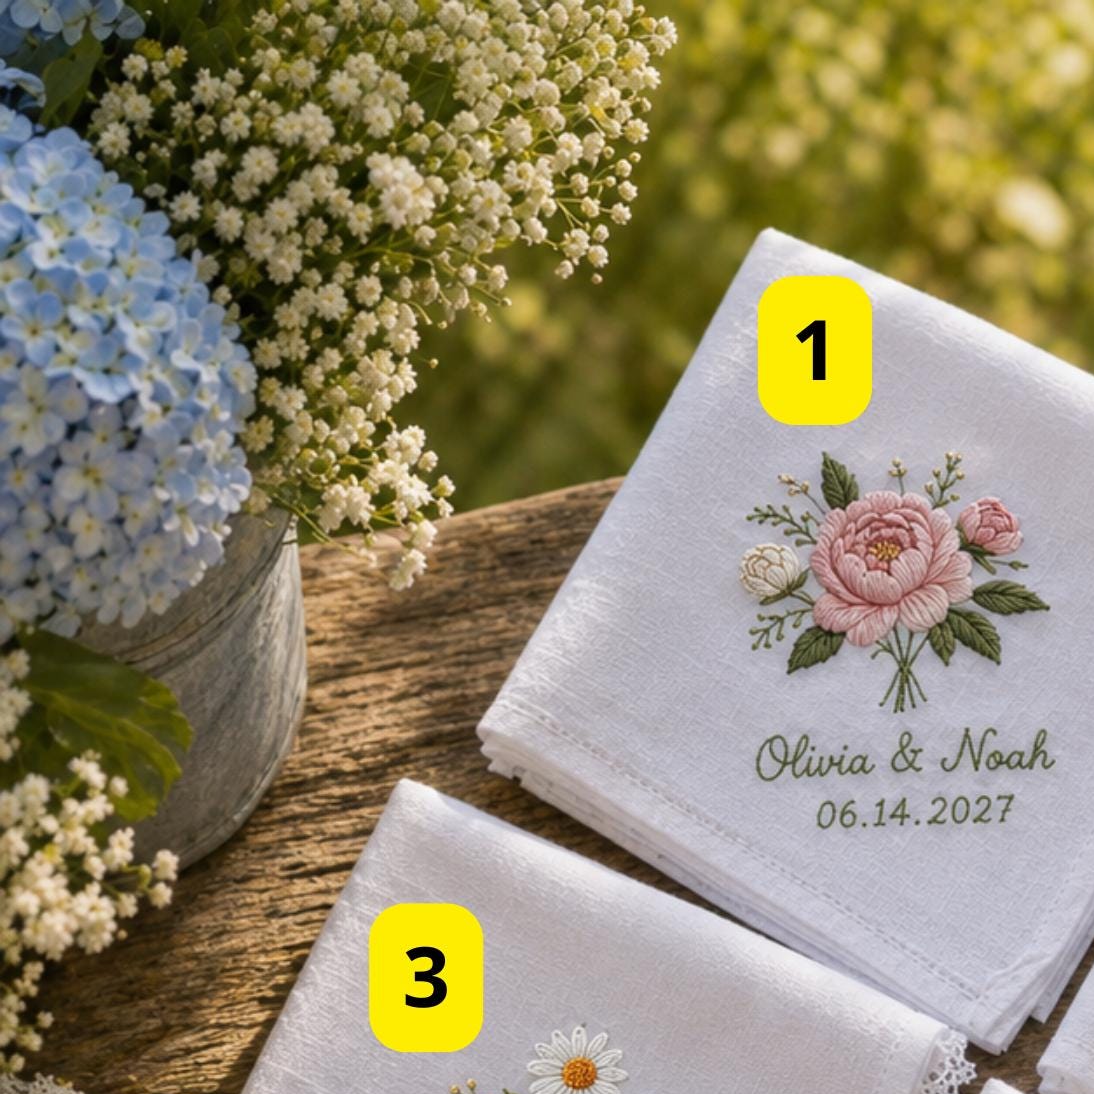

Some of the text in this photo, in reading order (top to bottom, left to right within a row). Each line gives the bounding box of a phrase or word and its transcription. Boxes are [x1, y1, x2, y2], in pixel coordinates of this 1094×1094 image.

[756, 728, 1056, 781] Olivia & Noah
[817, 794, 1015, 829] 06.14.2027
